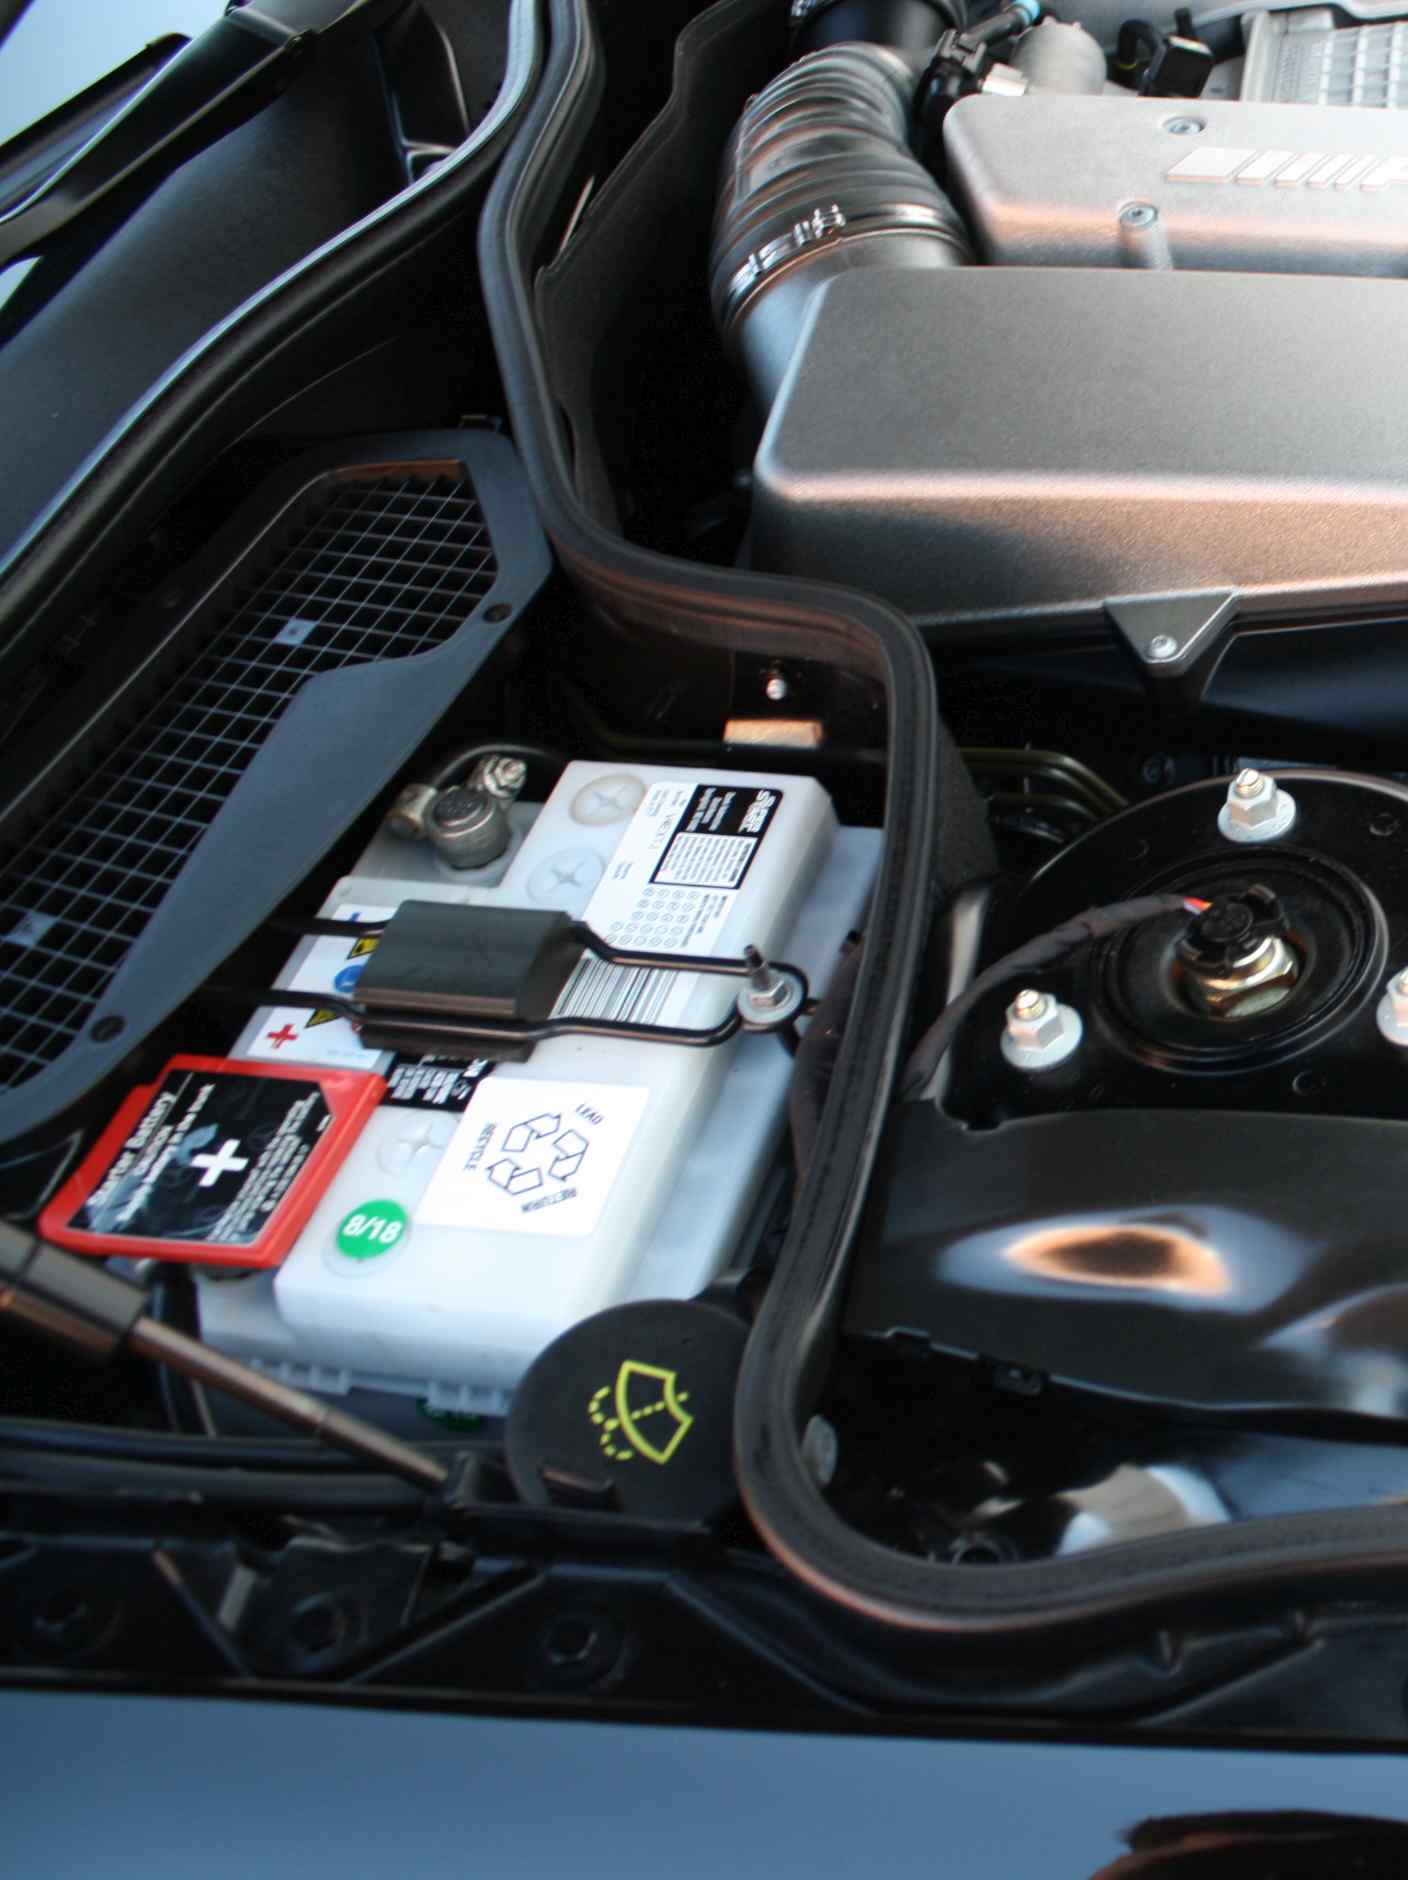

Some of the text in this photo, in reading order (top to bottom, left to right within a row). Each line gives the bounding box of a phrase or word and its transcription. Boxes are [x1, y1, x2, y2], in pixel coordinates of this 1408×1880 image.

[125, 1091, 177, 1149] Battery
[575, 1103, 605, 1125] LEAD
[342, 1214, 403, 1244] 8/18
